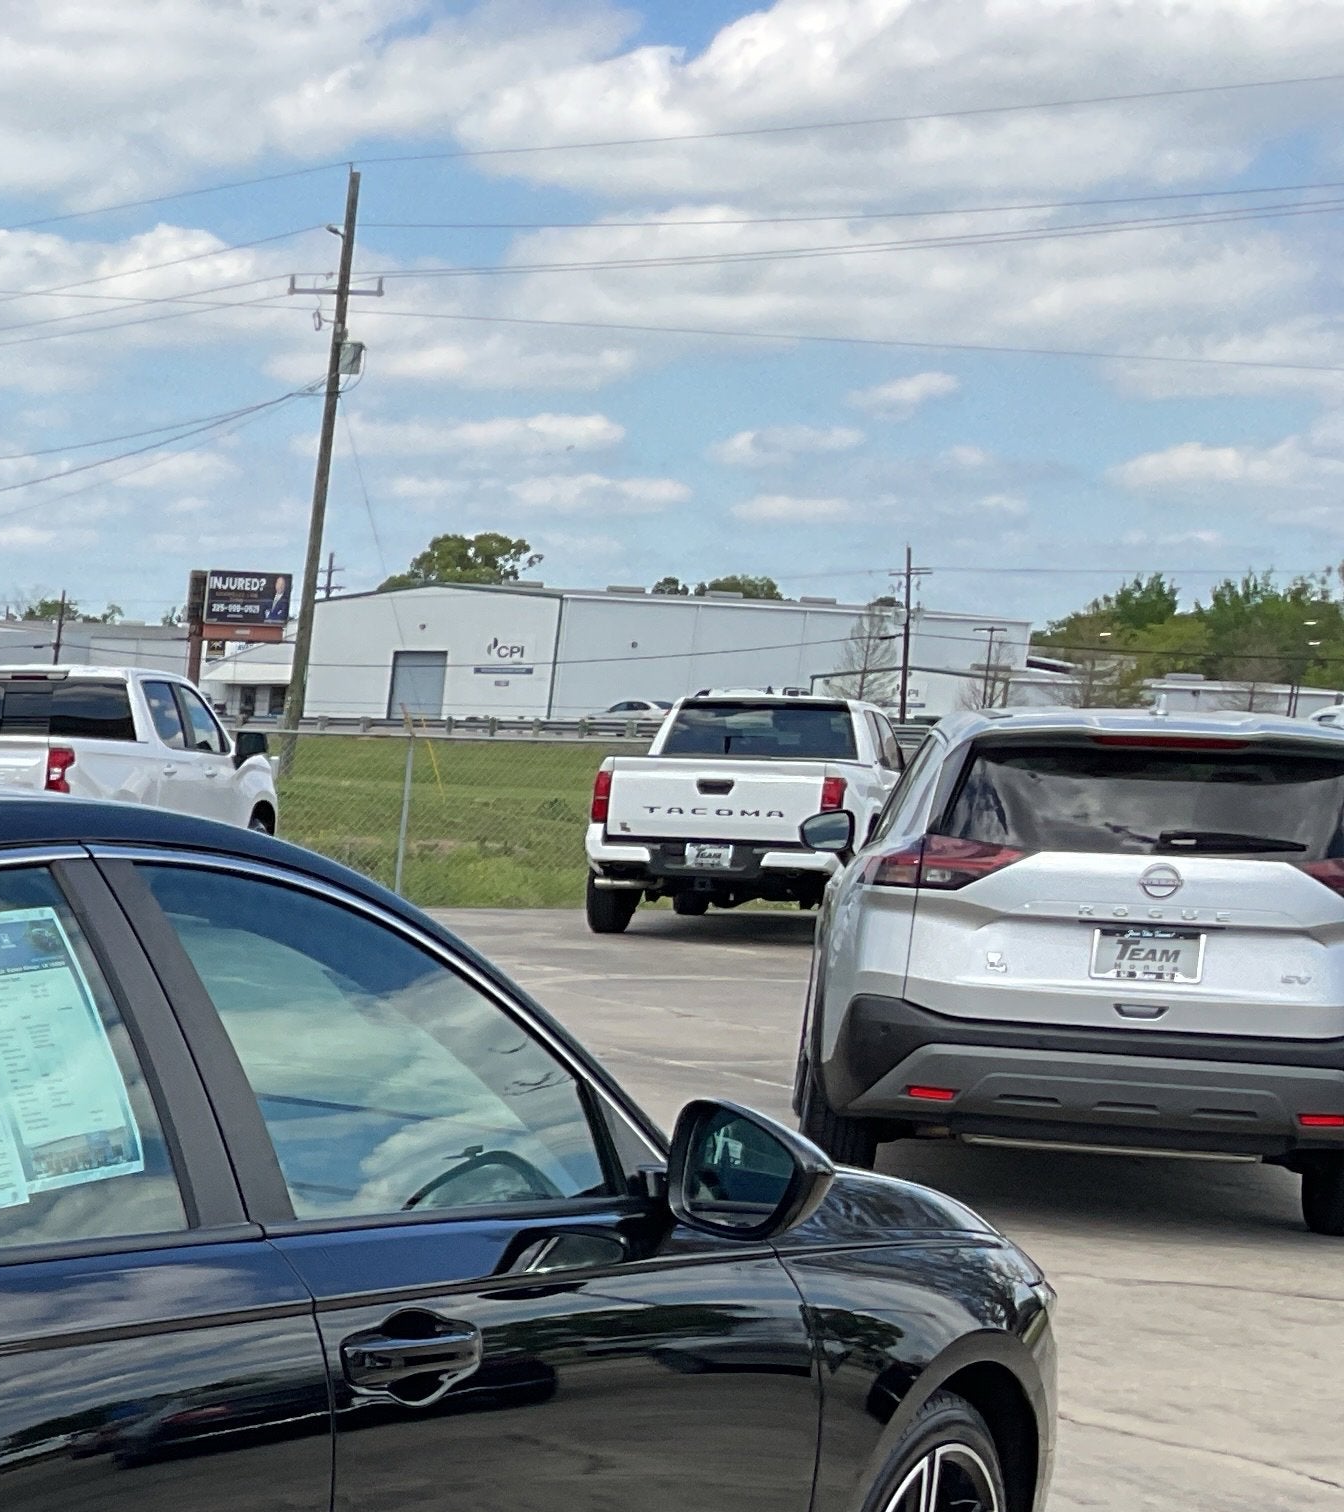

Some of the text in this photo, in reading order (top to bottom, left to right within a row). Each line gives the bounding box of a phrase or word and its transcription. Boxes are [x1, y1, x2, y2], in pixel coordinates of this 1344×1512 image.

[209, 576, 267, 591] INJURED?
[496, 645, 525, 658] CPI
[642, 806, 785, 818] TACOMA
[1078, 904, 1232, 922] ROGUE
[1116, 939, 1182, 963] TEAM
